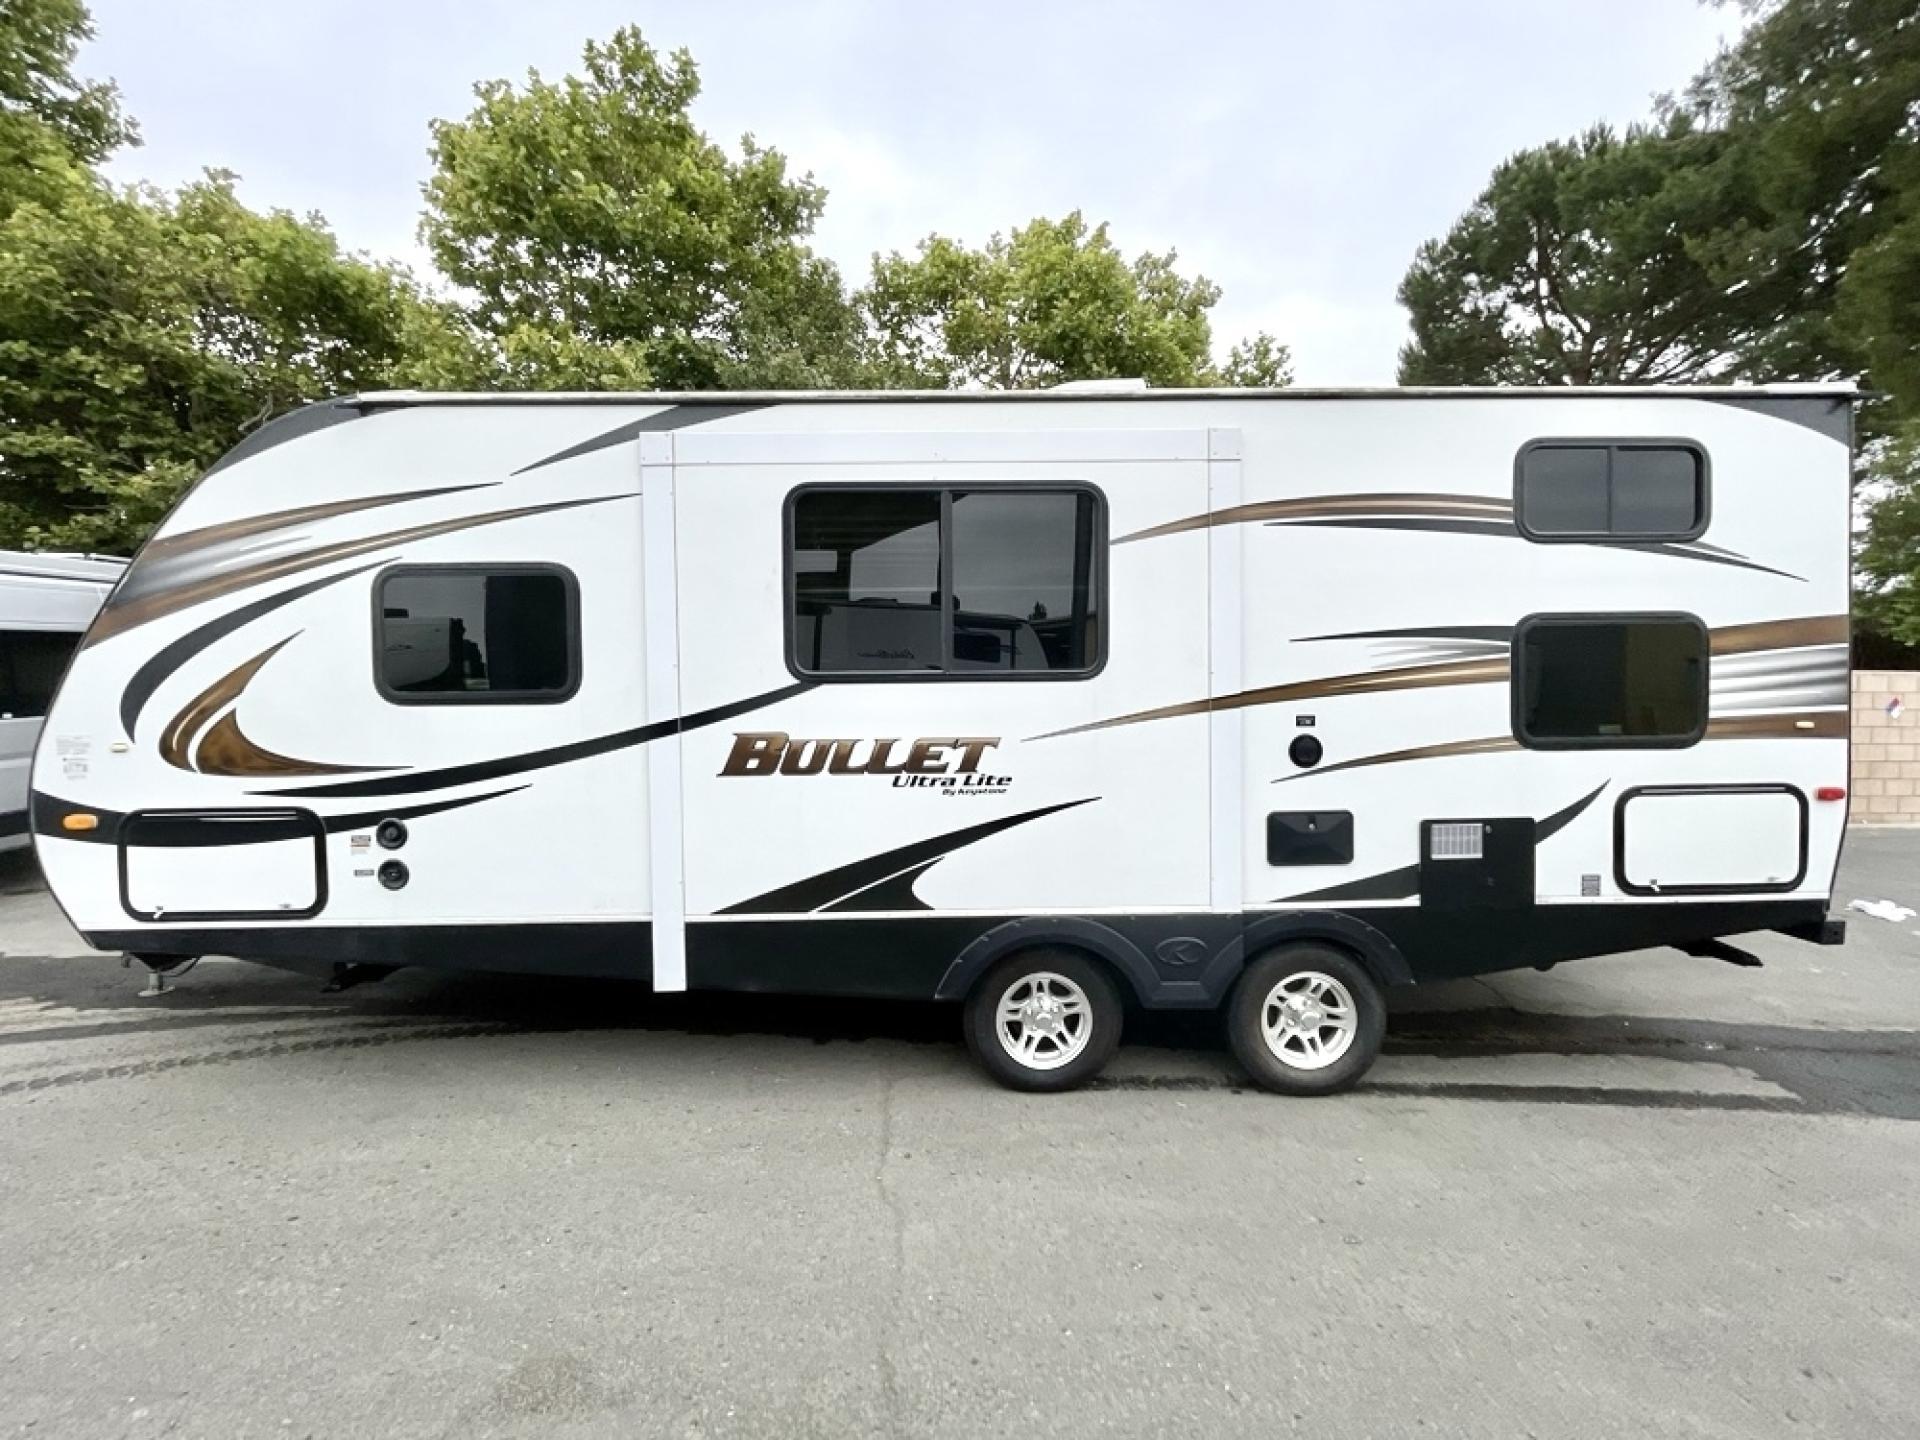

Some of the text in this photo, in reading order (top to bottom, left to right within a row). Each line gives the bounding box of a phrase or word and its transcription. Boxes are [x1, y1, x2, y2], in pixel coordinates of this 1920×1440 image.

[716, 731, 1001, 776] BULLET
[892, 774, 1013, 788] Ultra Lite
